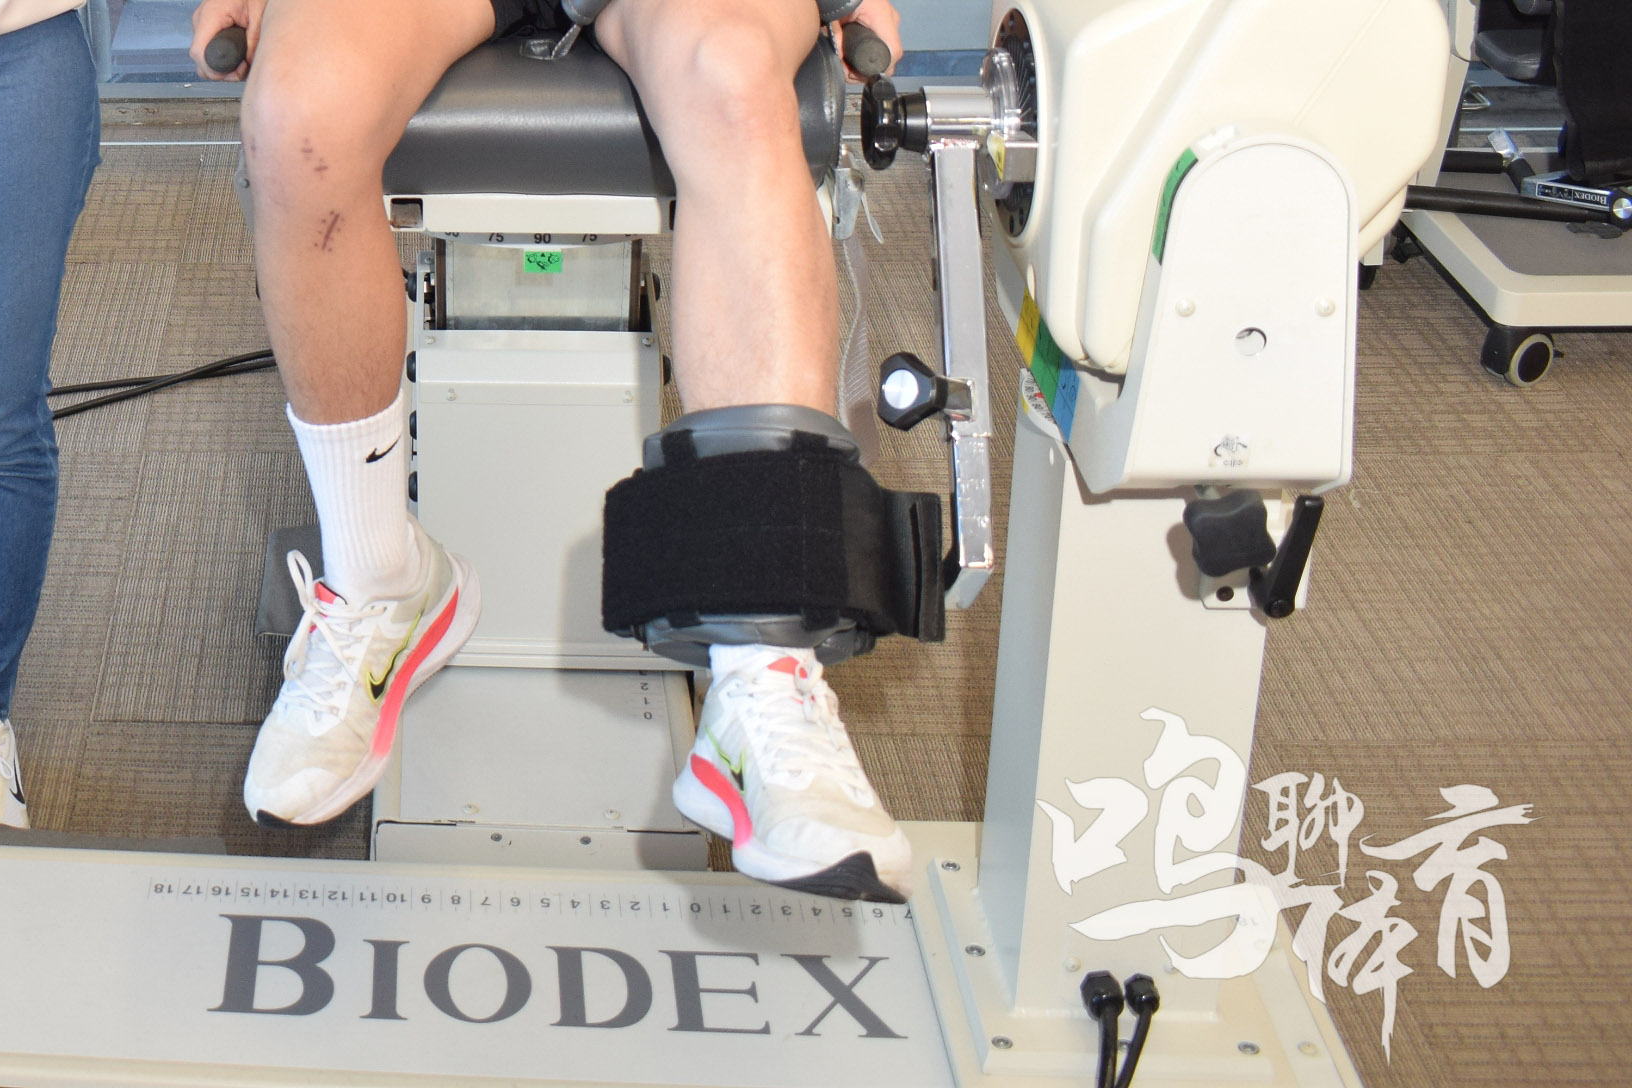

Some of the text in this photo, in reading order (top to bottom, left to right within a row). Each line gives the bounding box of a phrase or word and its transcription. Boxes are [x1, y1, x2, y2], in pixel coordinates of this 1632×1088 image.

[1574, 191, 1607, 204] BIODEX
[534, 233, 552, 244] 90
[639, 682, 649, 691] 2
[643, 711, 653, 720] 0
[154, 884, 174, 894] 18
[182, 885, 203, 895] 17
[211, 886, 232, 896] 16
[240, 887, 261, 897] 15
[270, 888, 290, 898] 14
[298, 889, 319, 900] 13
[327, 890, 348, 901] 12
[359, 892, 378, 902] 11
[386, 892, 408, 903] 10
[420, 894, 432, 904] 9
[450, 894, 461, 905] 8
[480, 896, 491, 906] 7
[510, 897, 521, 907] 6
[540, 897, 551, 908] 5
[570, 899, 581, 909] 4
[600, 899, 611, 910] 3
[629, 901, 641, 911] 2
[662, 902, 671, 912] 1
[690, 902, 702, 913] 0
[722, 903, 731, 914] 1
[751, 904, 762, 915] 2
[781, 905, 792, 916] 3
[811, 907, 822, 917] 4
[841, 907, 853, 918] 5
[872, 908, 884, 918] 6
[206, 913, 909, 1039] BIODEX
